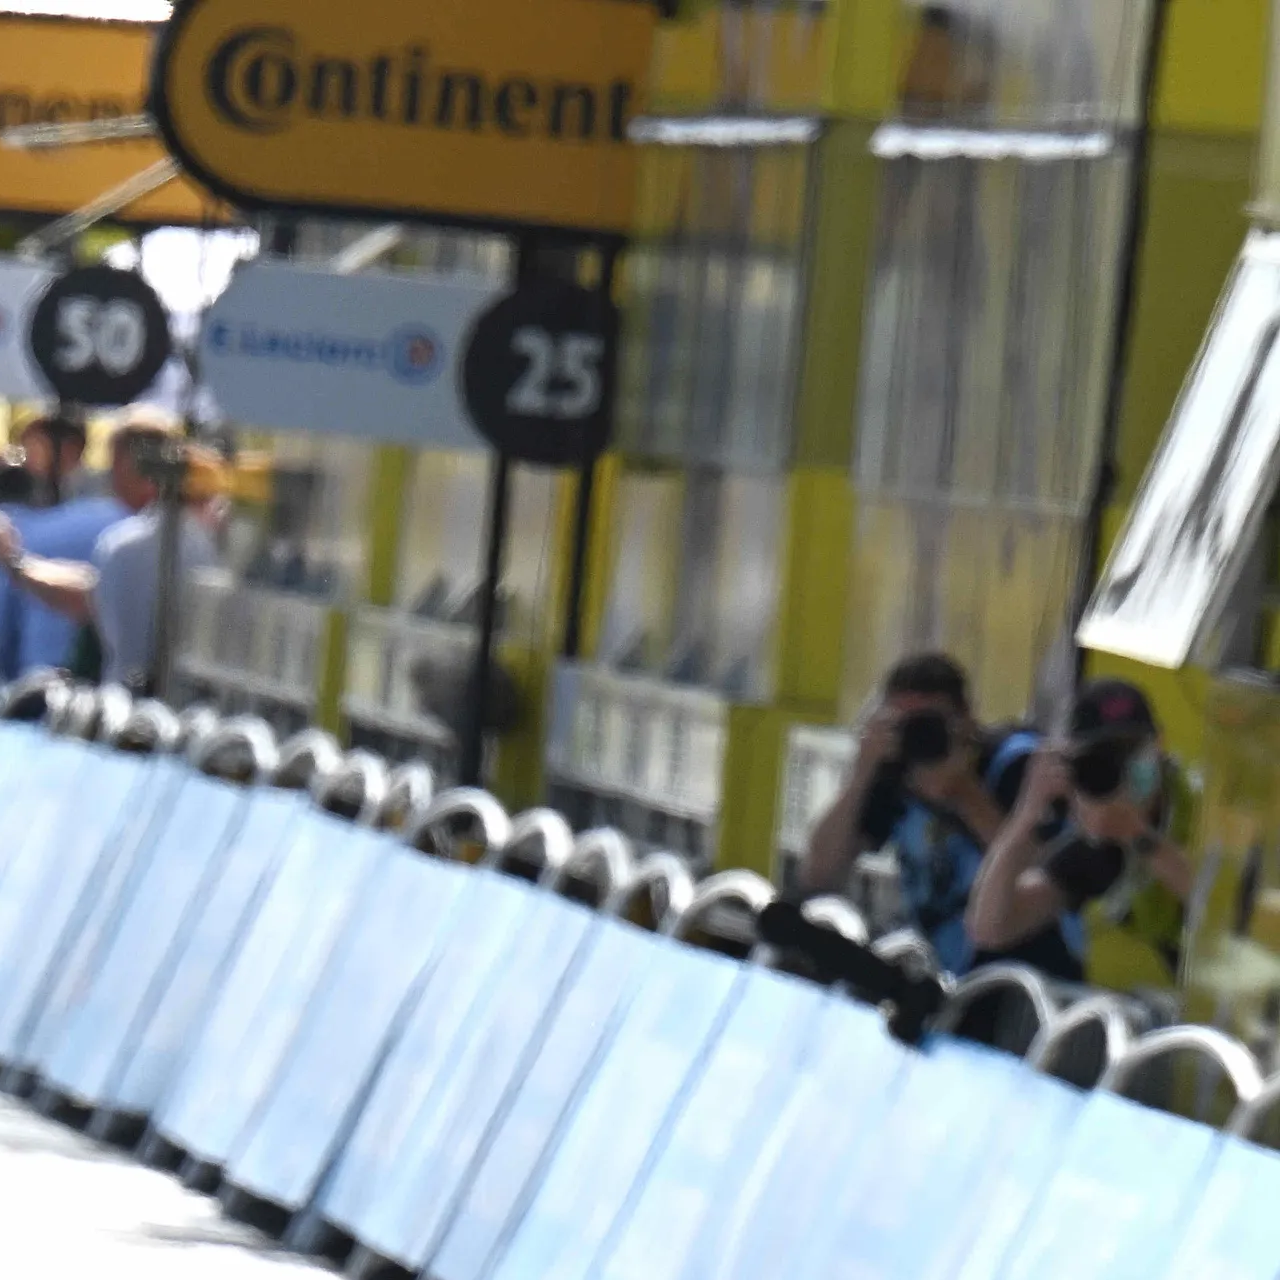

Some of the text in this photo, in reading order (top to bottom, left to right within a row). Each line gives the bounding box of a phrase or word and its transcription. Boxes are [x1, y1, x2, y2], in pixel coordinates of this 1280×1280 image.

[204, 24, 634, 143] Continent
[54, 297, 144, 378] 50
[506, 324, 605, 418] 25
